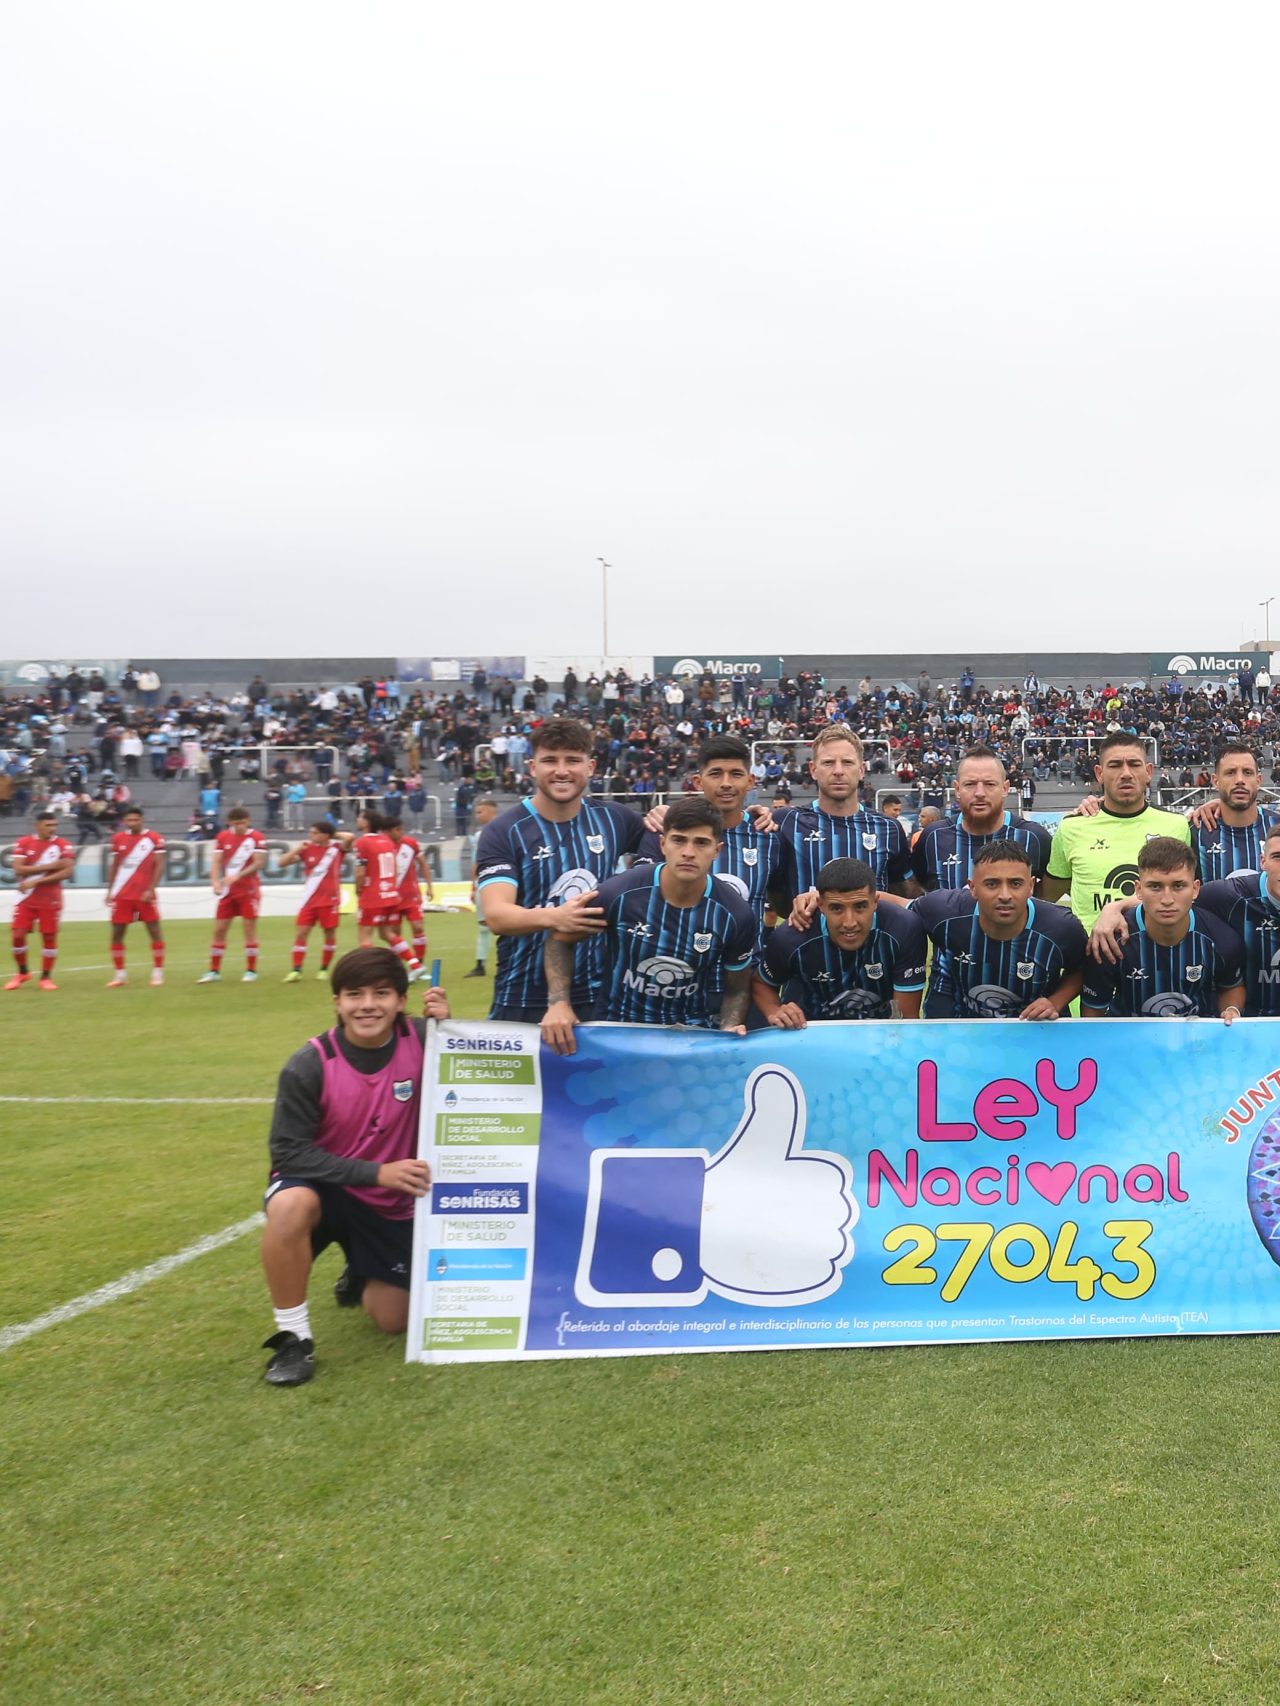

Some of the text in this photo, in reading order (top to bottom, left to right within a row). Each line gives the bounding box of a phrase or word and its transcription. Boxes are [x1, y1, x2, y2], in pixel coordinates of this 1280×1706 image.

[706, 660, 761, 675] Macro
[1200, 656, 1252, 671] Macro
[621, 966, 700, 999] Macro
[447, 1038, 523, 1052] SONRISAS
[455, 1058, 522, 1069] MINISTERIO
[455, 1069, 514, 1079] DE SALUD
[448, 1117, 501, 1125] MINISTERIO
[438, 1196, 521, 1209] SONRISAS
[448, 1220, 516, 1230] MINISTERIO
[446, 1232, 507, 1242] DE SALUD
[881, 1220, 1157, 1302] 27043
[613, 1320, 625, 1332] al
[628, 1319, 680, 1334] abordaje
[683, 1319, 726, 1333] integral
[739, 1318, 832, 1334] interdisciplinario
[835, 1318, 850, 1329] de
[853, 1317, 869, 1329] las
[872, 1318, 923, 1330] personas
[926, 1318, 949, 1330] que
[951, 1316, 1006, 1330] presentan
[1009, 1314, 1065, 1327] Trastornos
[1068, 1314, 1086, 1326] del
[1089, 1314, 1137, 1327] Espectro
